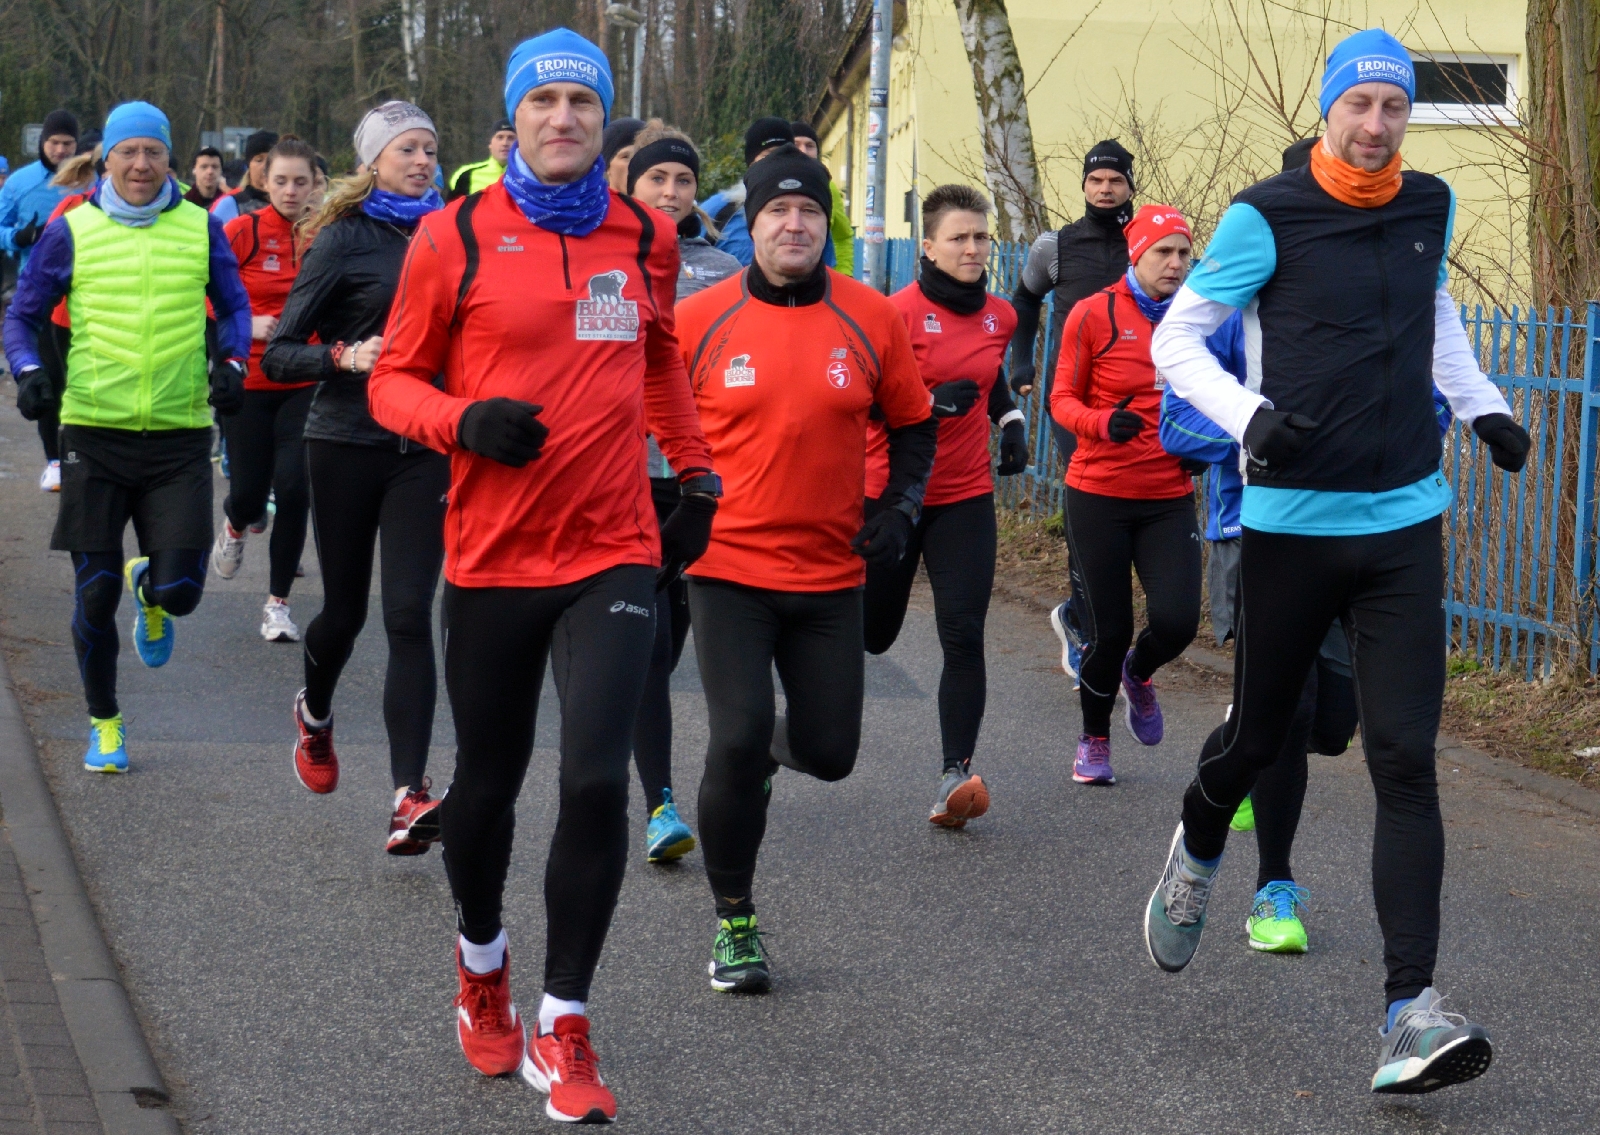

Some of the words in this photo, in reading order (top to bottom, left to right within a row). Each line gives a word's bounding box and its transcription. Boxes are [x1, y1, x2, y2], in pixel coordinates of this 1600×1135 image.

[536, 58, 599, 79] ERDINGER
[1357, 60, 1411, 81] ERDINGER
[538, 71, 599, 86] ALKOHOLFREI
[578, 302, 638, 317] BLOCK
[578, 316, 639, 332] HOUSE
[626, 604, 650, 617] asics
